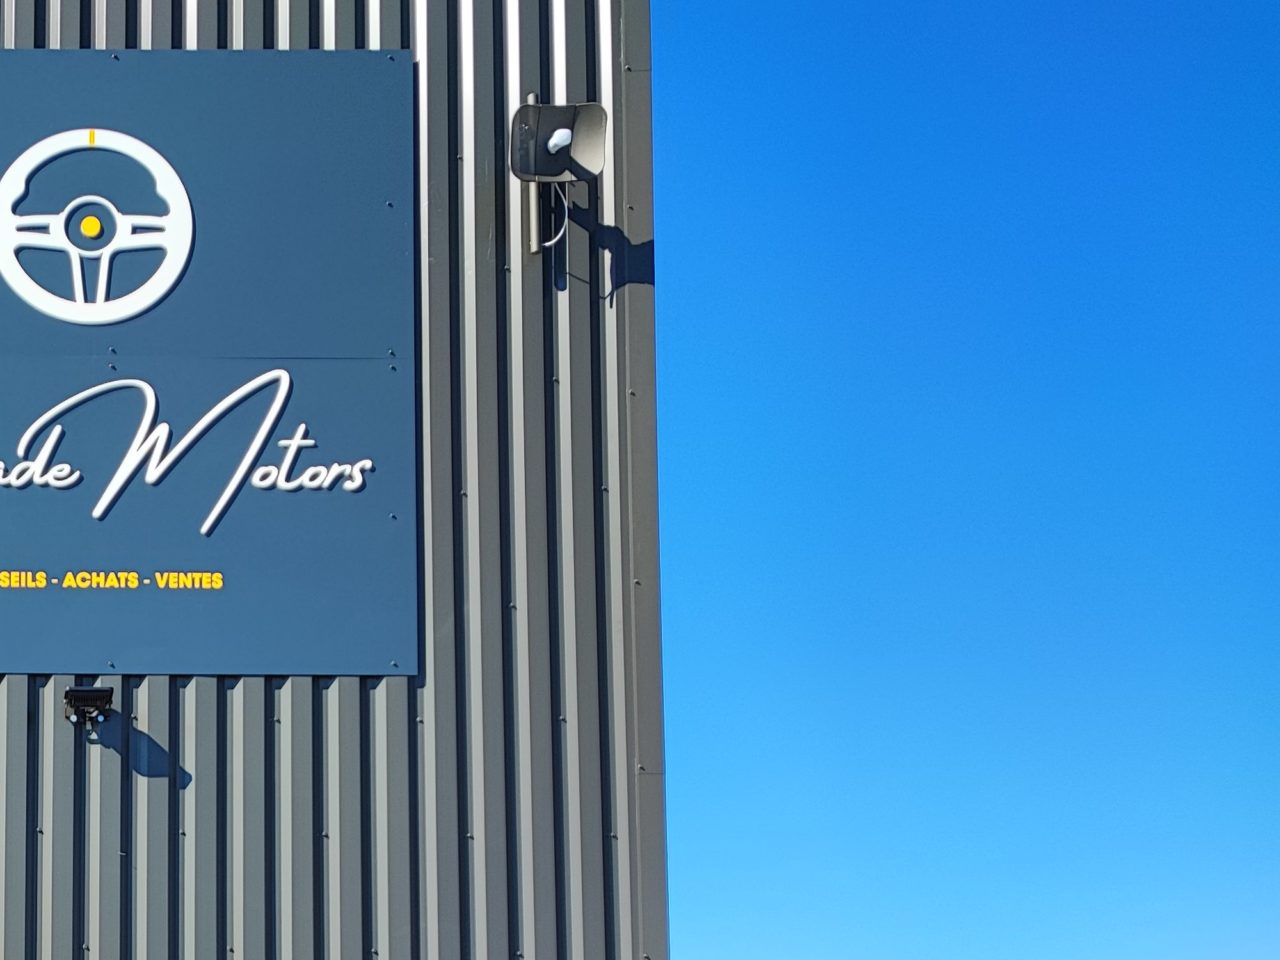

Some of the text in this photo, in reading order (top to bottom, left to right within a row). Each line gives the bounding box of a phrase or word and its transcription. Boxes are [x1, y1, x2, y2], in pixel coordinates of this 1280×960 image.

[17, 368, 376, 537] Motors
[62, 571, 139, 589] ACHATS
[155, 572, 223, 589] VENTES
